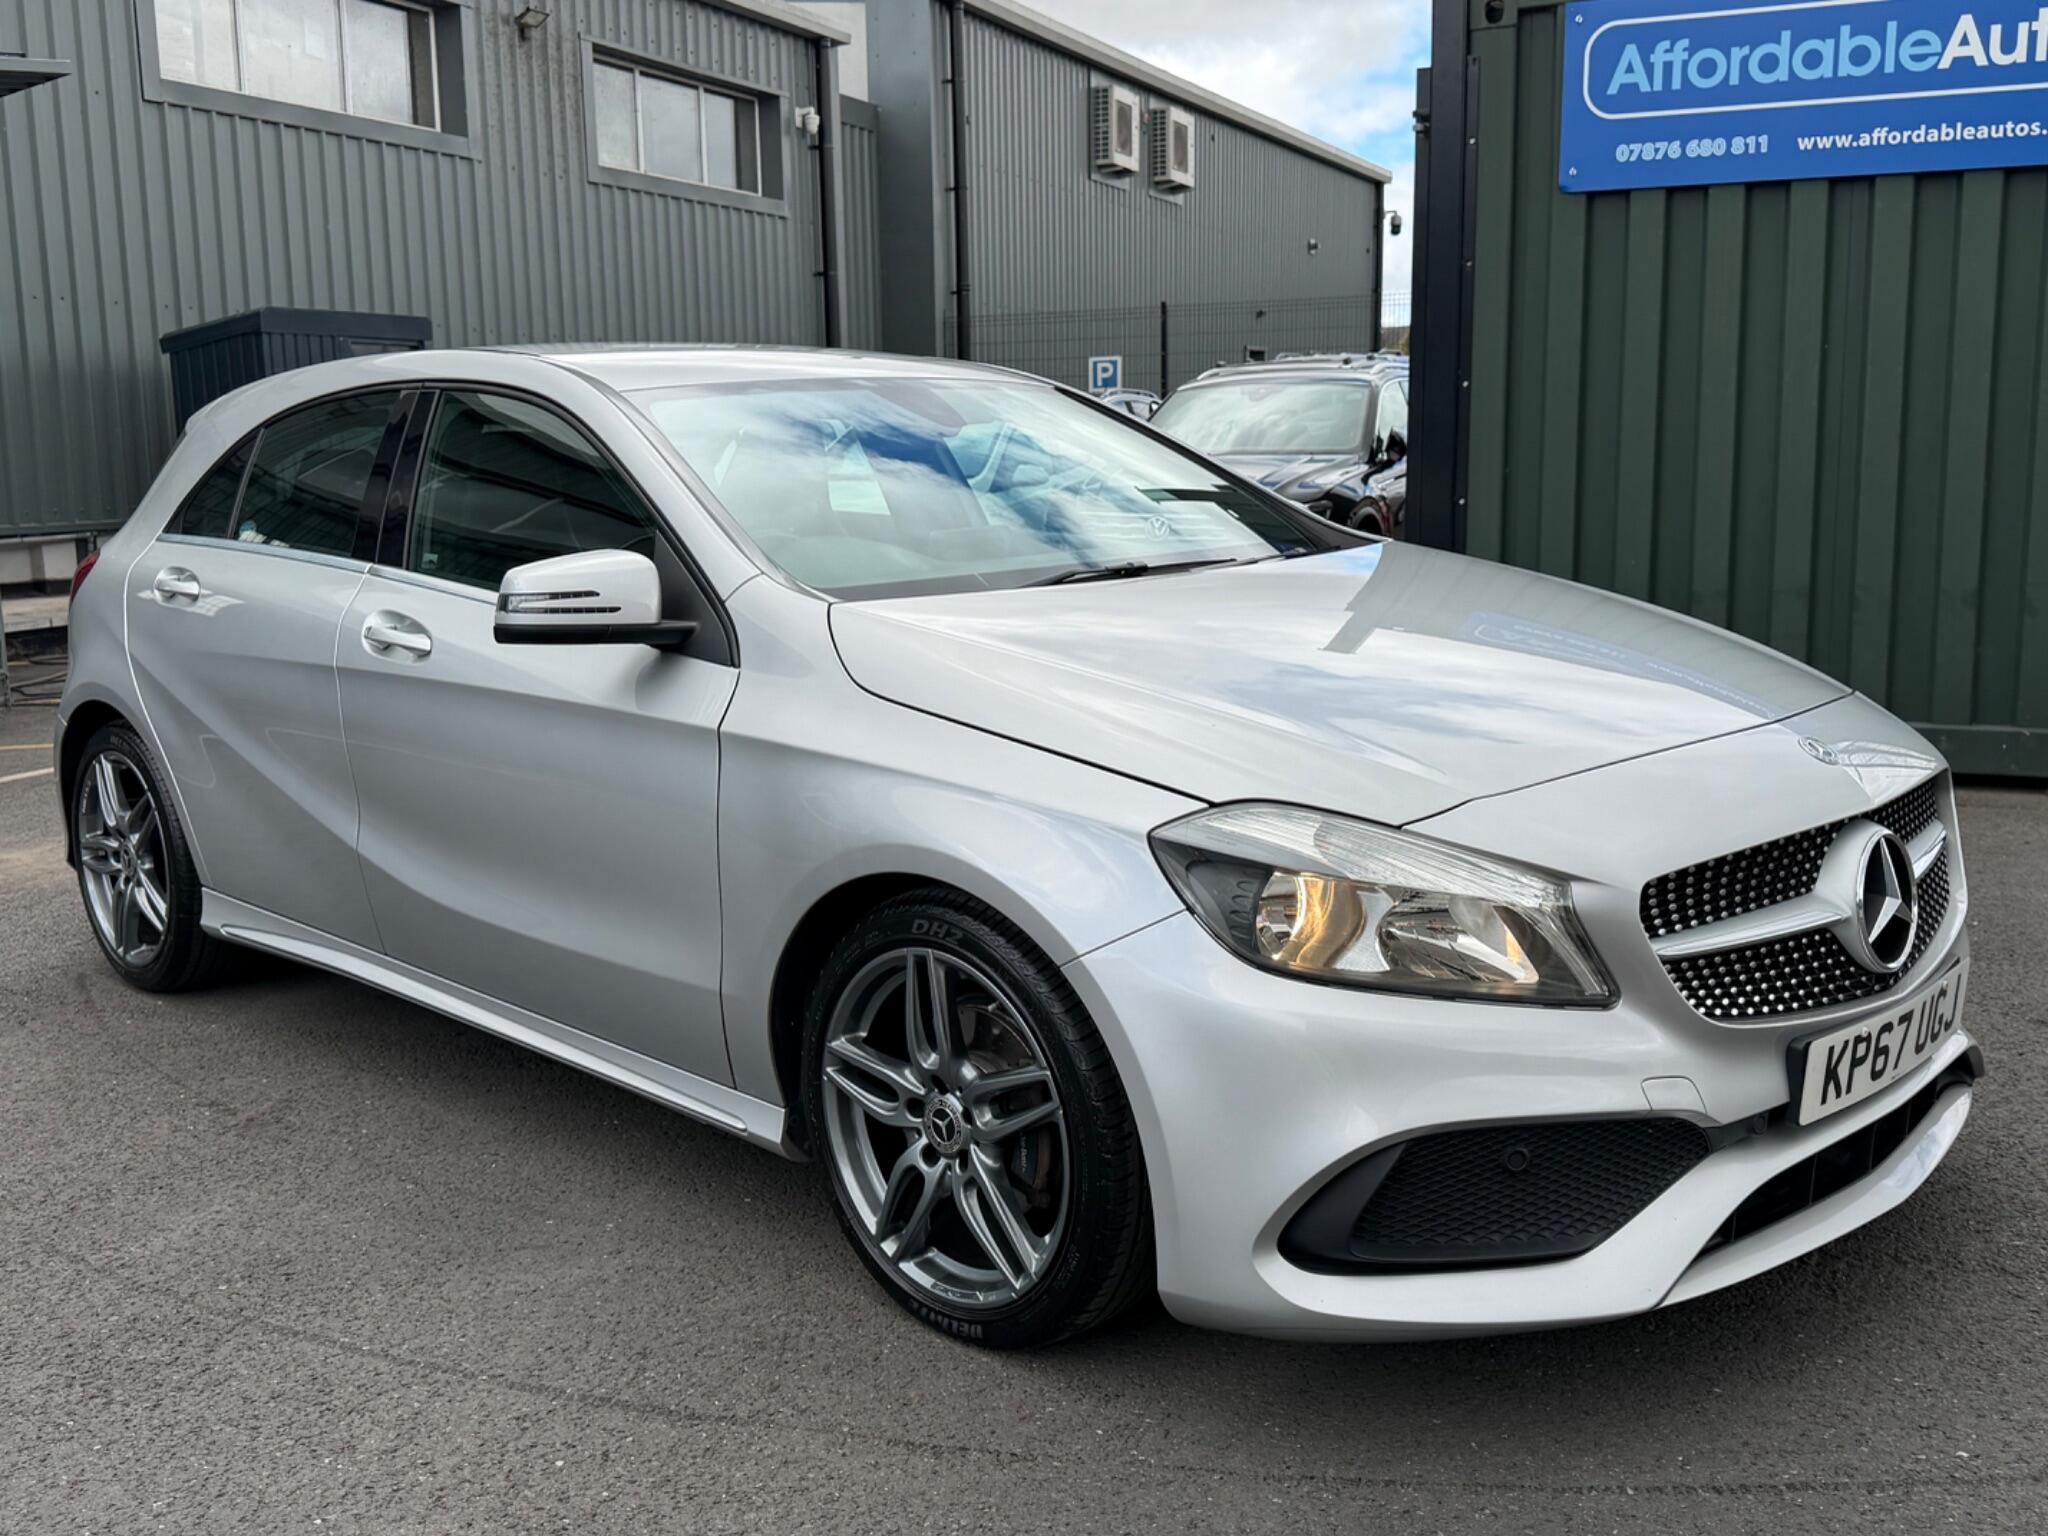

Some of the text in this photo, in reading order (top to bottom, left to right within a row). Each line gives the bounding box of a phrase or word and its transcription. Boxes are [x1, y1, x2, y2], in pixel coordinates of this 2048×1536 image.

[1731, 134, 1769, 155] 811
[1096, 362, 1114, 387] P
[1820, 973, 1962, 1106] KP67 UGJ
